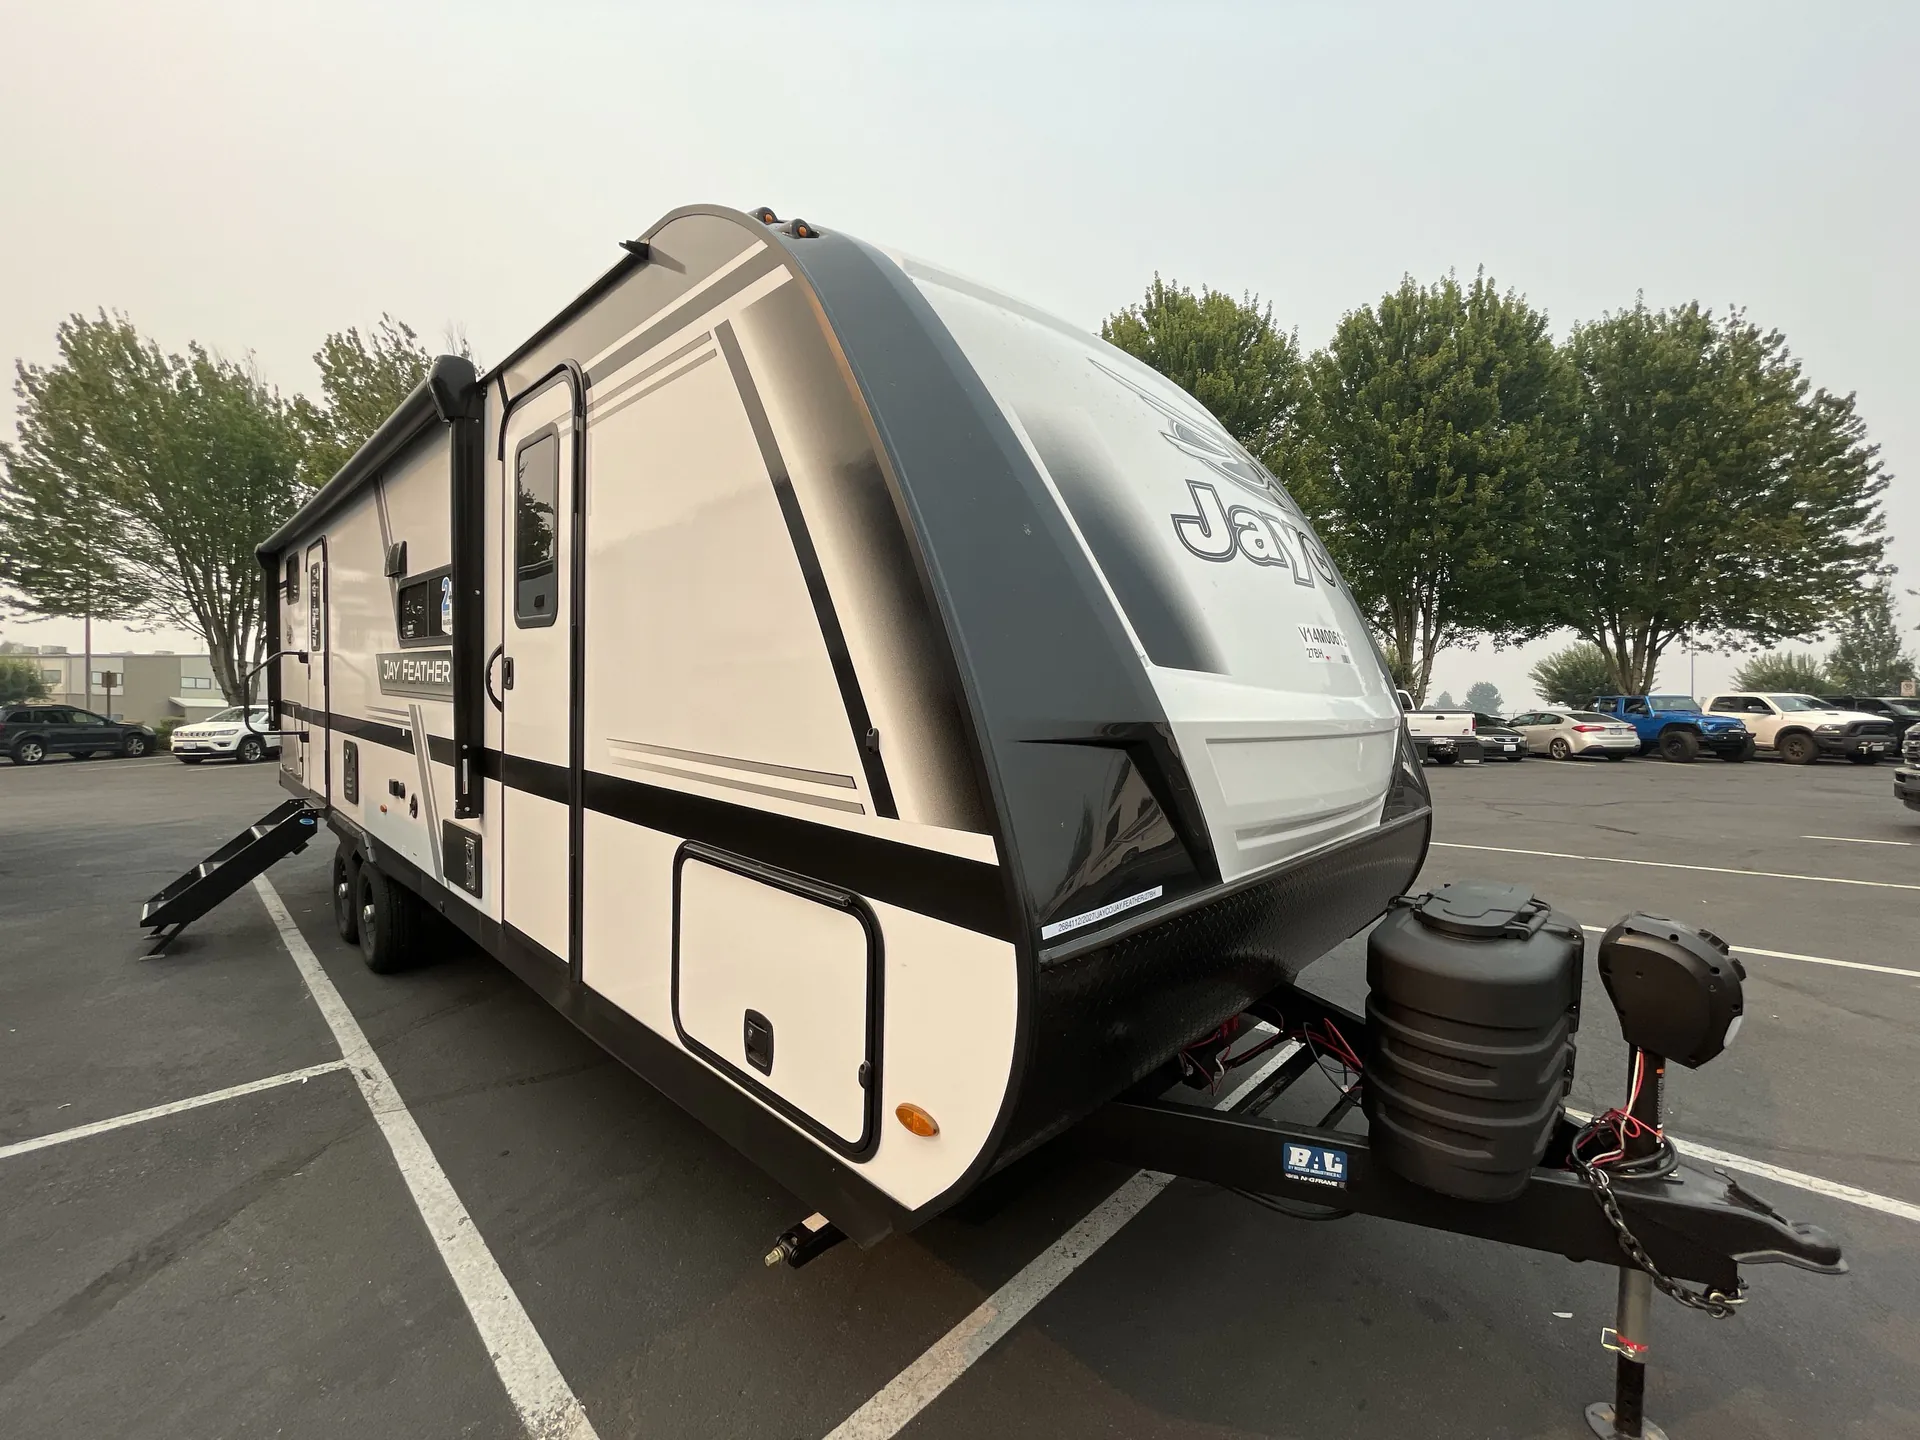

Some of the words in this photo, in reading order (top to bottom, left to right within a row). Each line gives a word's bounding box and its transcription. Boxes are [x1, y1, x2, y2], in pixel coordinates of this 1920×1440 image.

[1170, 478, 1342, 592] Jayc
[383, 659, 400, 680] JAY
[402, 659, 451, 683] FEATHER
